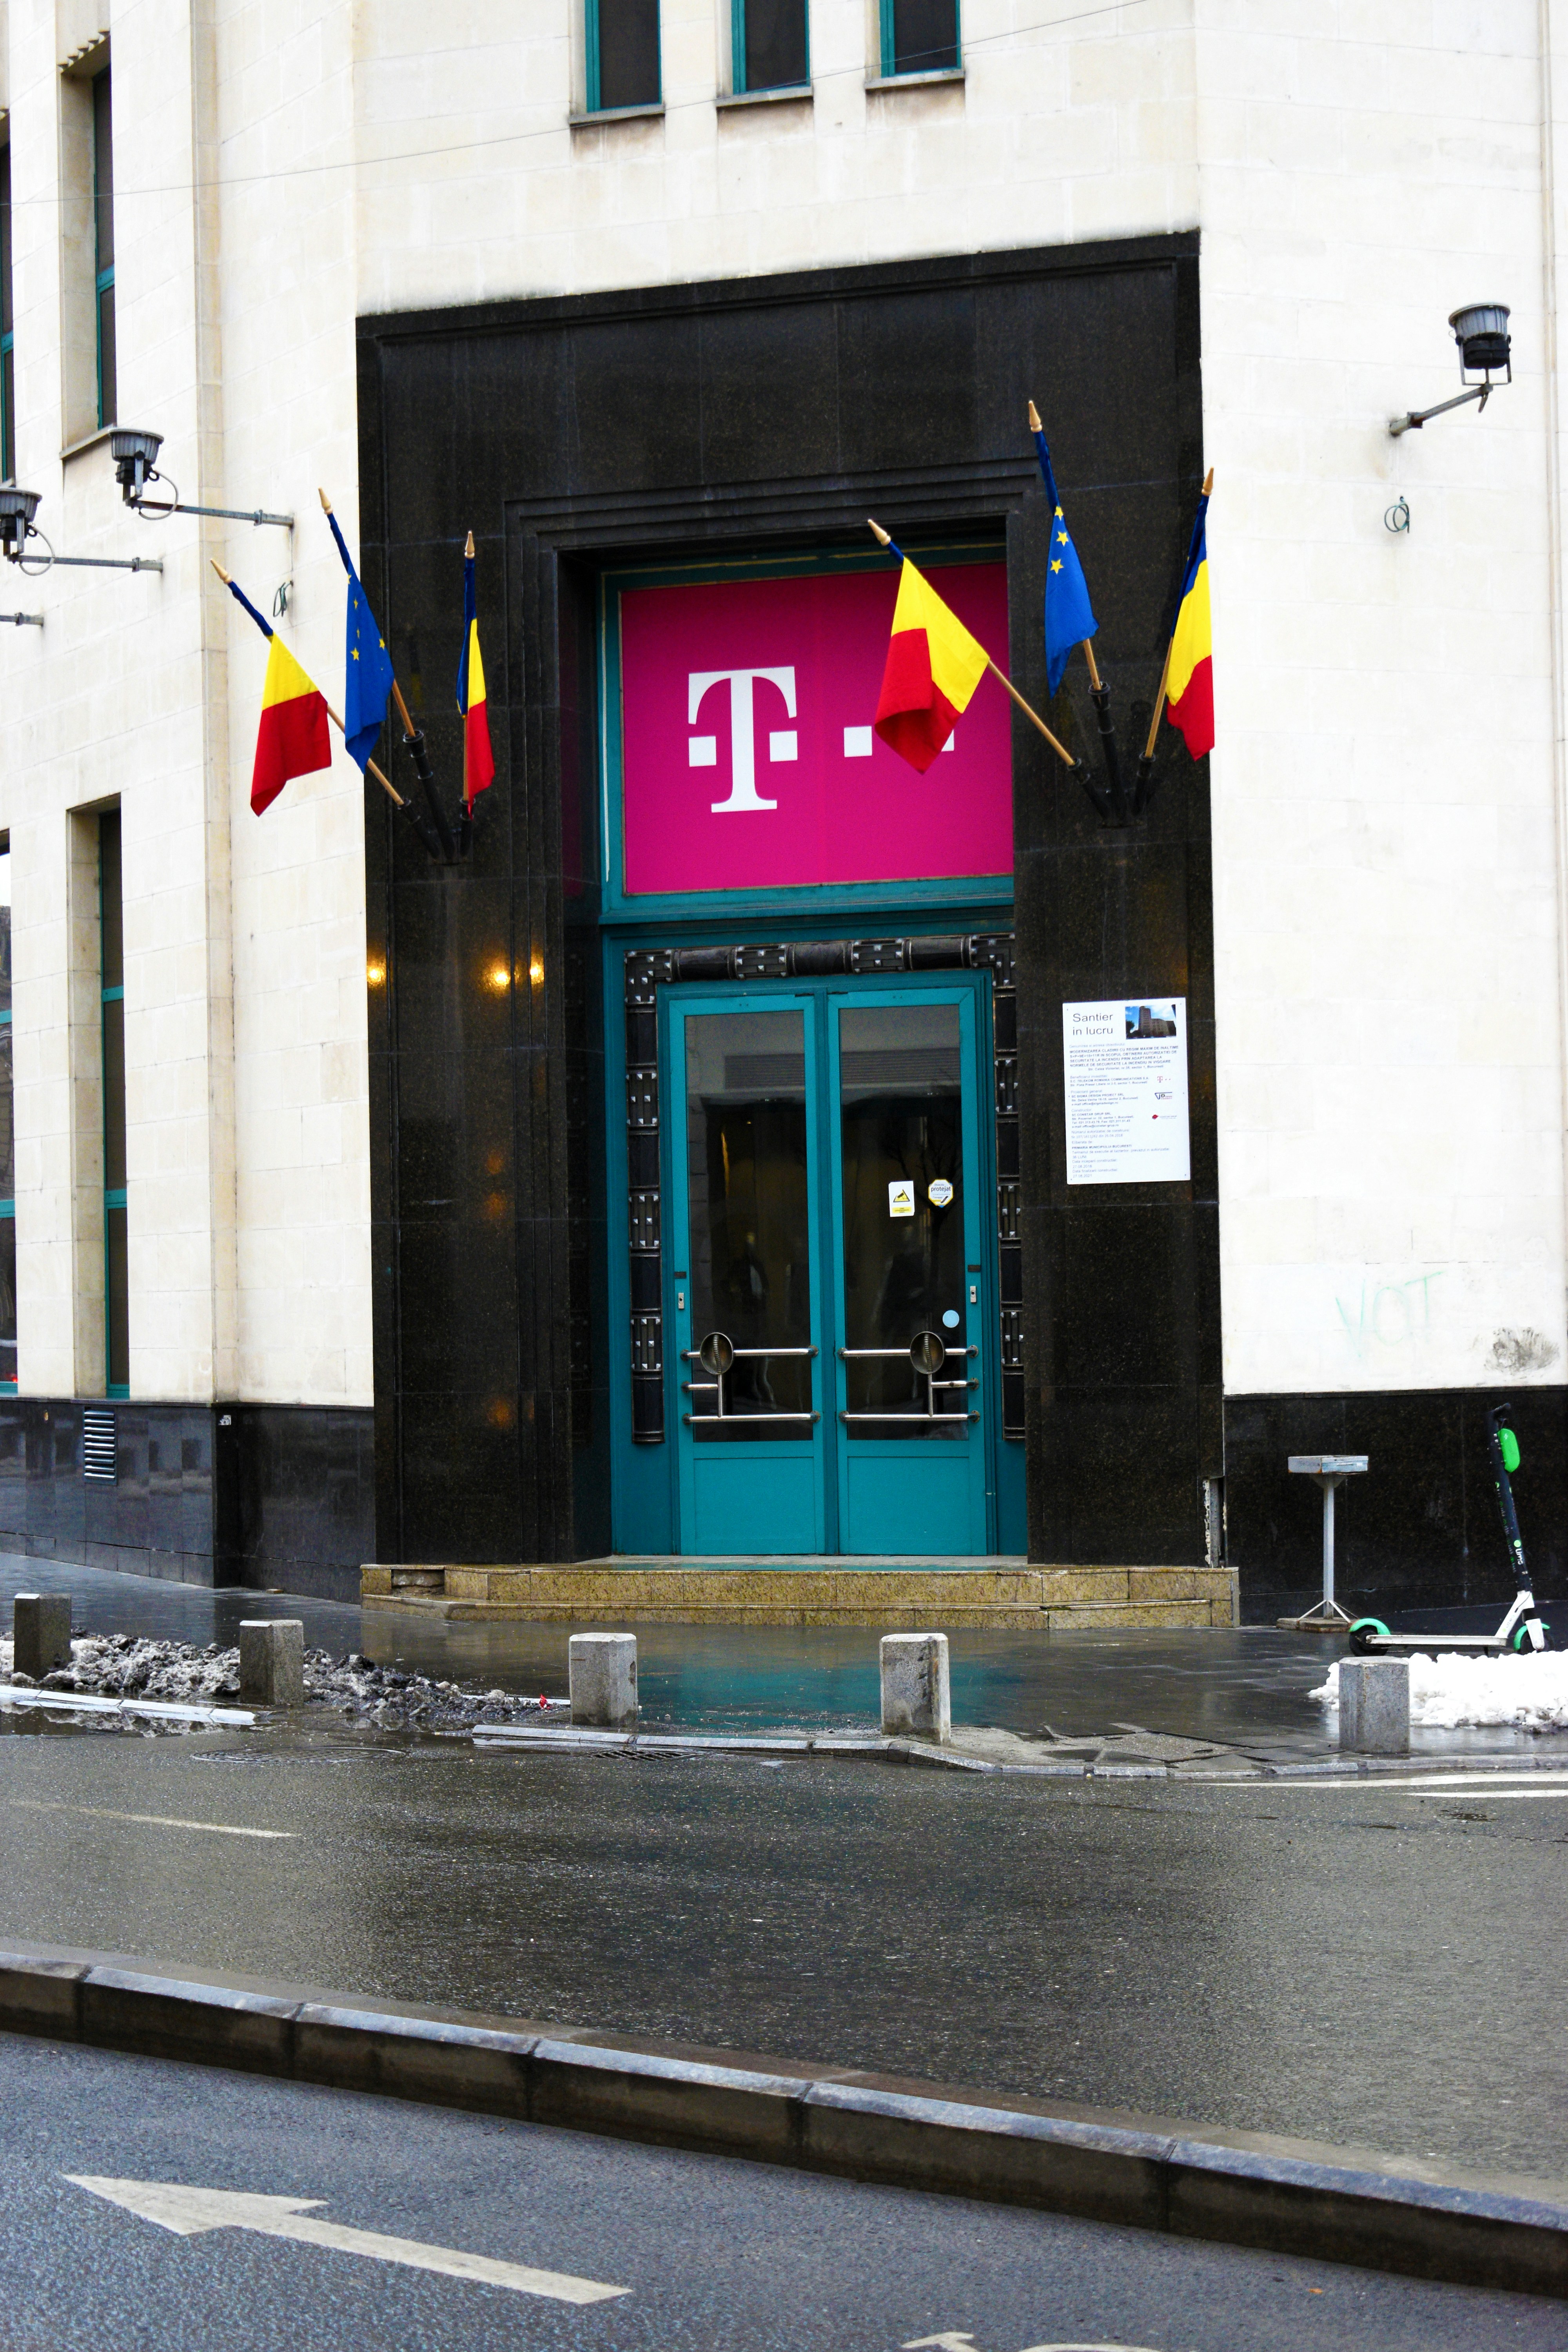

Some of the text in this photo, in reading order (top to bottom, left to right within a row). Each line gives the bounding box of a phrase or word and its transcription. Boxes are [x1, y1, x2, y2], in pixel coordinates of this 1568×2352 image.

[688, 666, 798, 813] T
[1073, 1013, 1113, 1022] Santier
[1073, 1027, 1082, 1035] in
